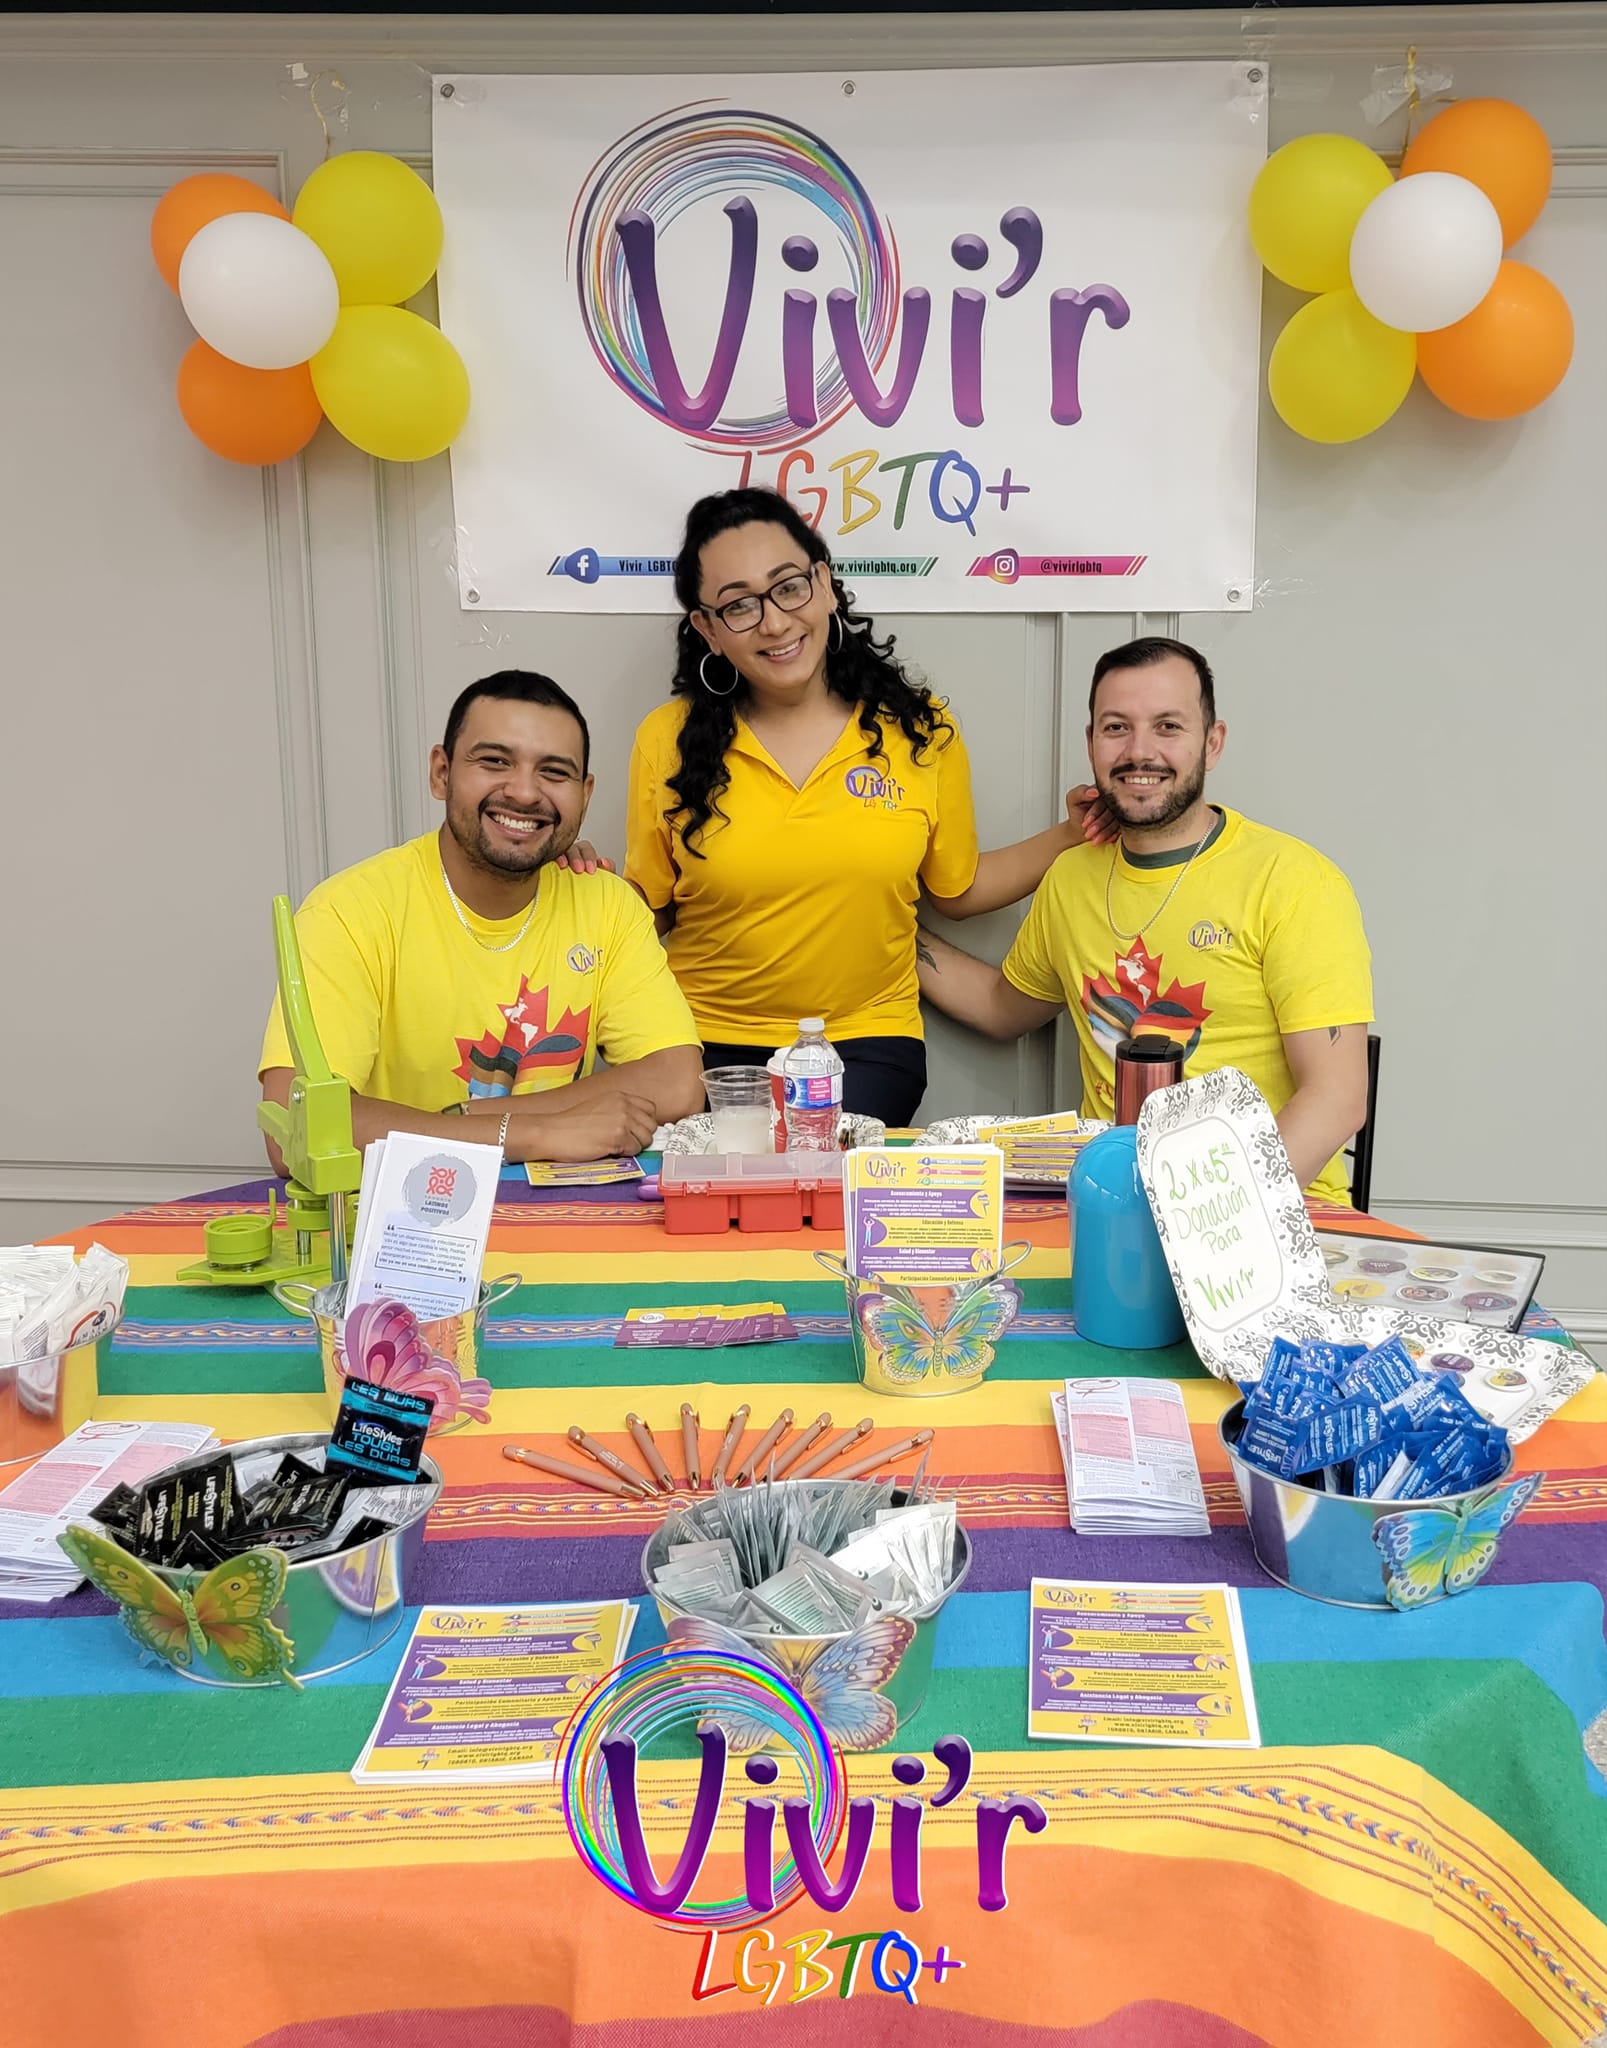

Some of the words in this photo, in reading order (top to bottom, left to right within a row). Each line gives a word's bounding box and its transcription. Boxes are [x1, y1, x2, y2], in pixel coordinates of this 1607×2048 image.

[614, 195, 1129, 431] Vivi'r
[619, 560, 643, 572] Vivir
[1040, 558, 1102, 574] @vivirlgbtq
[1162, 1160, 1187, 1200] 2
[1200, 1225, 1242, 1256] Para
[351, 1422, 403, 1446] LifeStyles
[351, 1431, 401, 1456] TOUGH
[337, 1437, 365, 1454] LES
[369, 1449, 411, 1468] DURS
[154, 1489, 168, 1542] LIFESTYLES
[203, 1475, 217, 1531] LIFESTYLES
